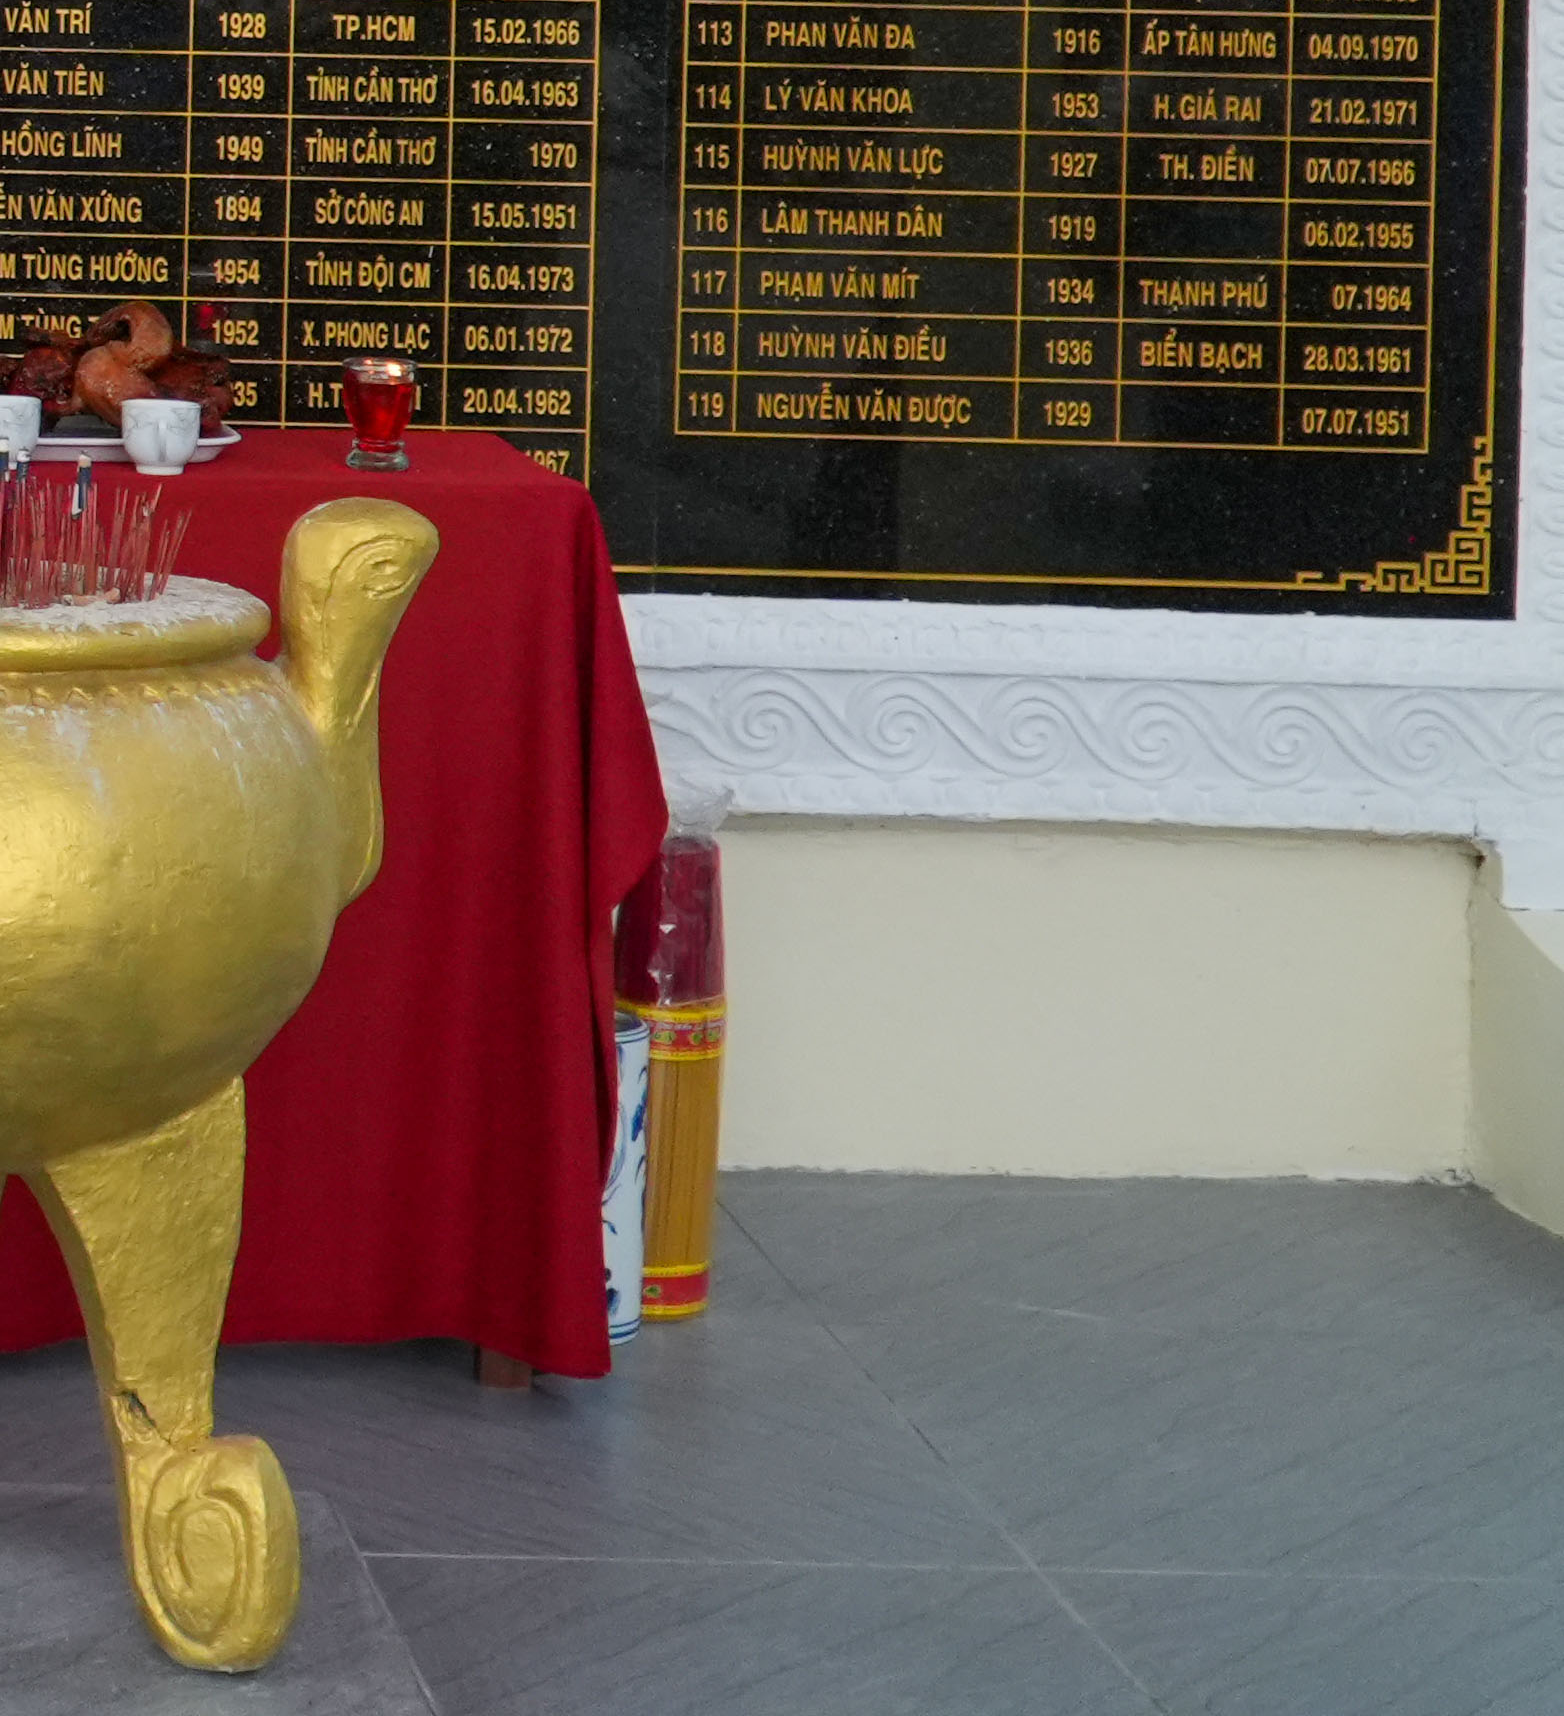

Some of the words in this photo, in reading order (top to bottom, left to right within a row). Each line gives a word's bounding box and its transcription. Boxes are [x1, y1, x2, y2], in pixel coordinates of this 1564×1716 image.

[2, 62, 49, 95] VĂN
[217, 73, 265, 101] 1939
[306, 66, 350, 102] TỈNH
[353, 66, 394, 103] CẦN
[471, 79, 579, 107] 16.04.1963
[690, 330, 726, 357] 118
[758, 325, 837, 359] HUỲNH
[841, 327, 888, 360] VĂN
[892, 324, 947, 363] ĐIỀU
[1045, 339, 1094, 366] 1936
[1140, 329, 1193, 369] BIỂN
[1199, 341, 1263, 374] BẠCH
[1303, 344, 1412, 373] 28.03.1961
